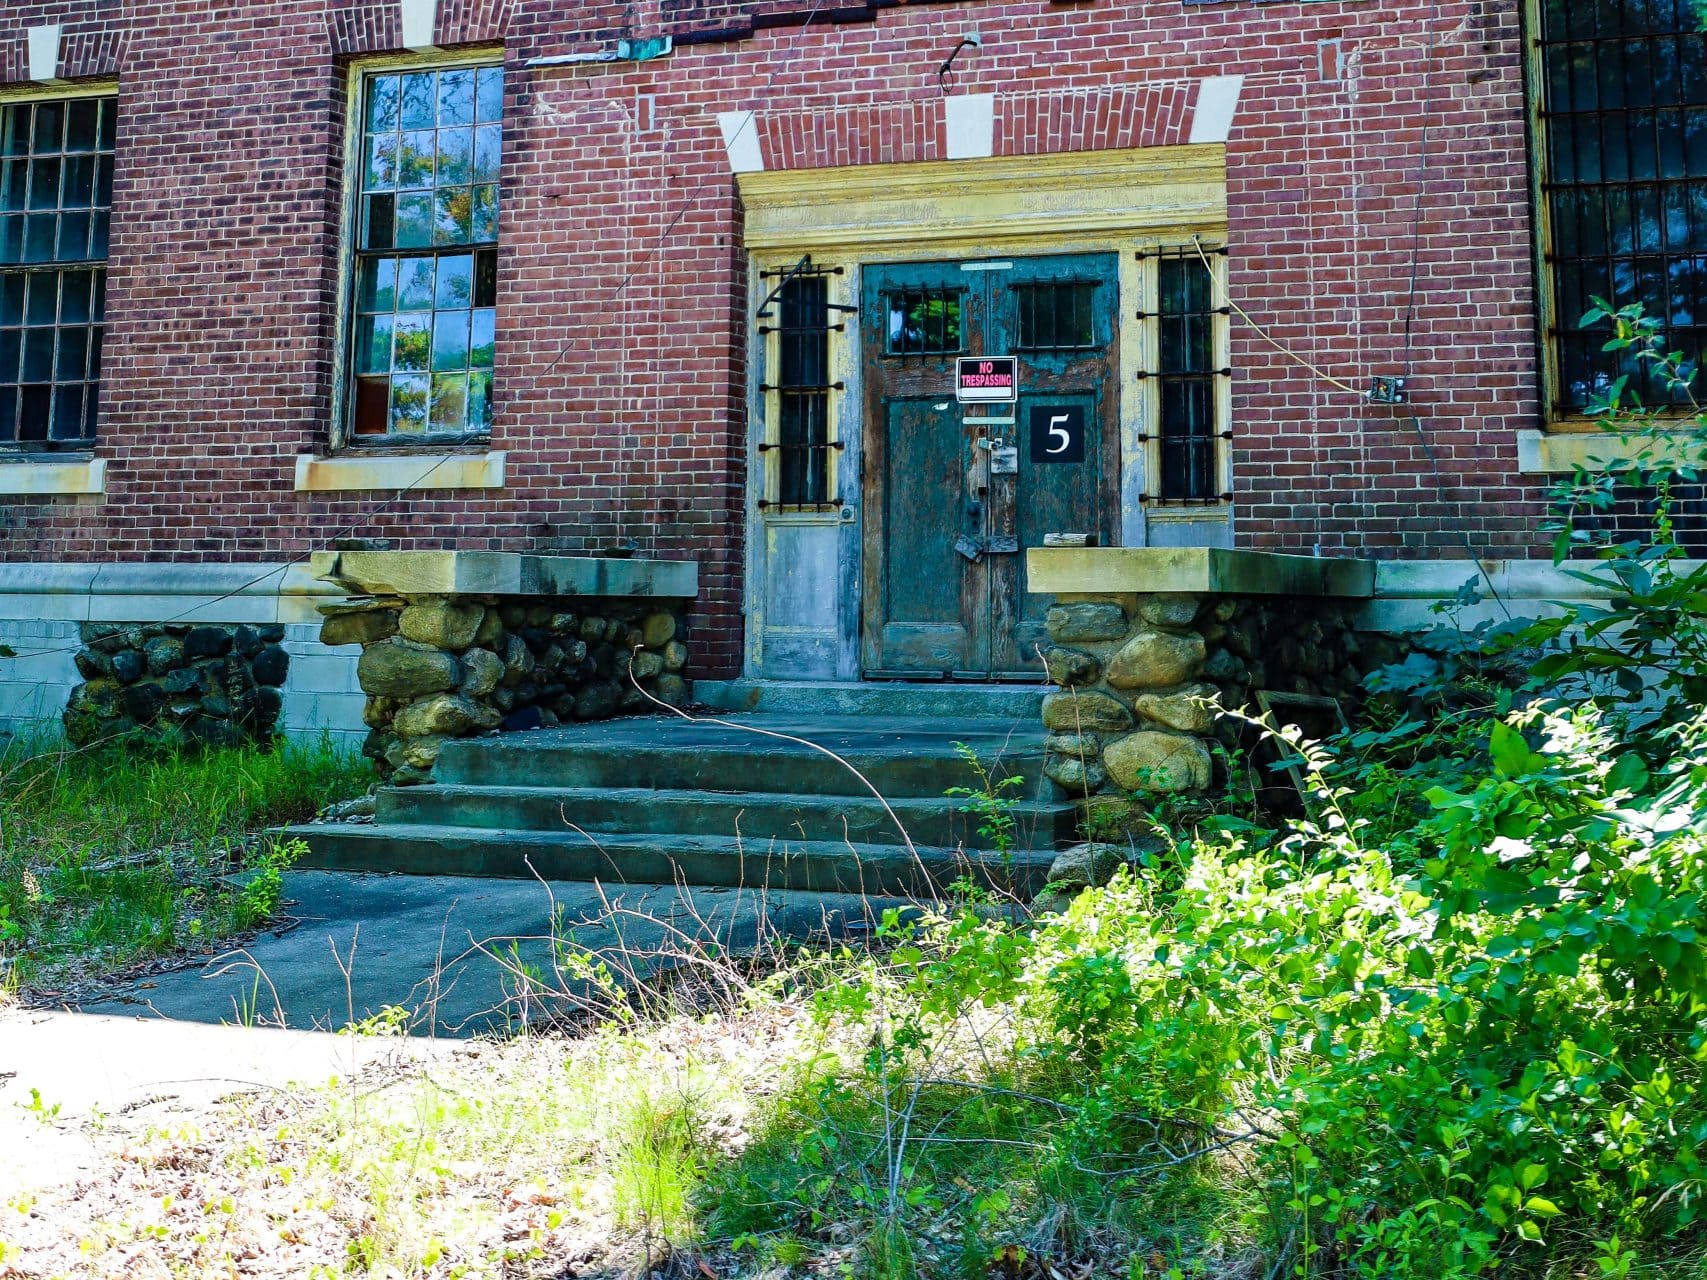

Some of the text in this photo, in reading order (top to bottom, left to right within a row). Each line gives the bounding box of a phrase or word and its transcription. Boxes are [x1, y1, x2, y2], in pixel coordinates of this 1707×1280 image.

[979, 361, 994, 374] NO
[961, 374, 1012, 386] TRESPASSING
[1045, 413, 1070, 454] 5
